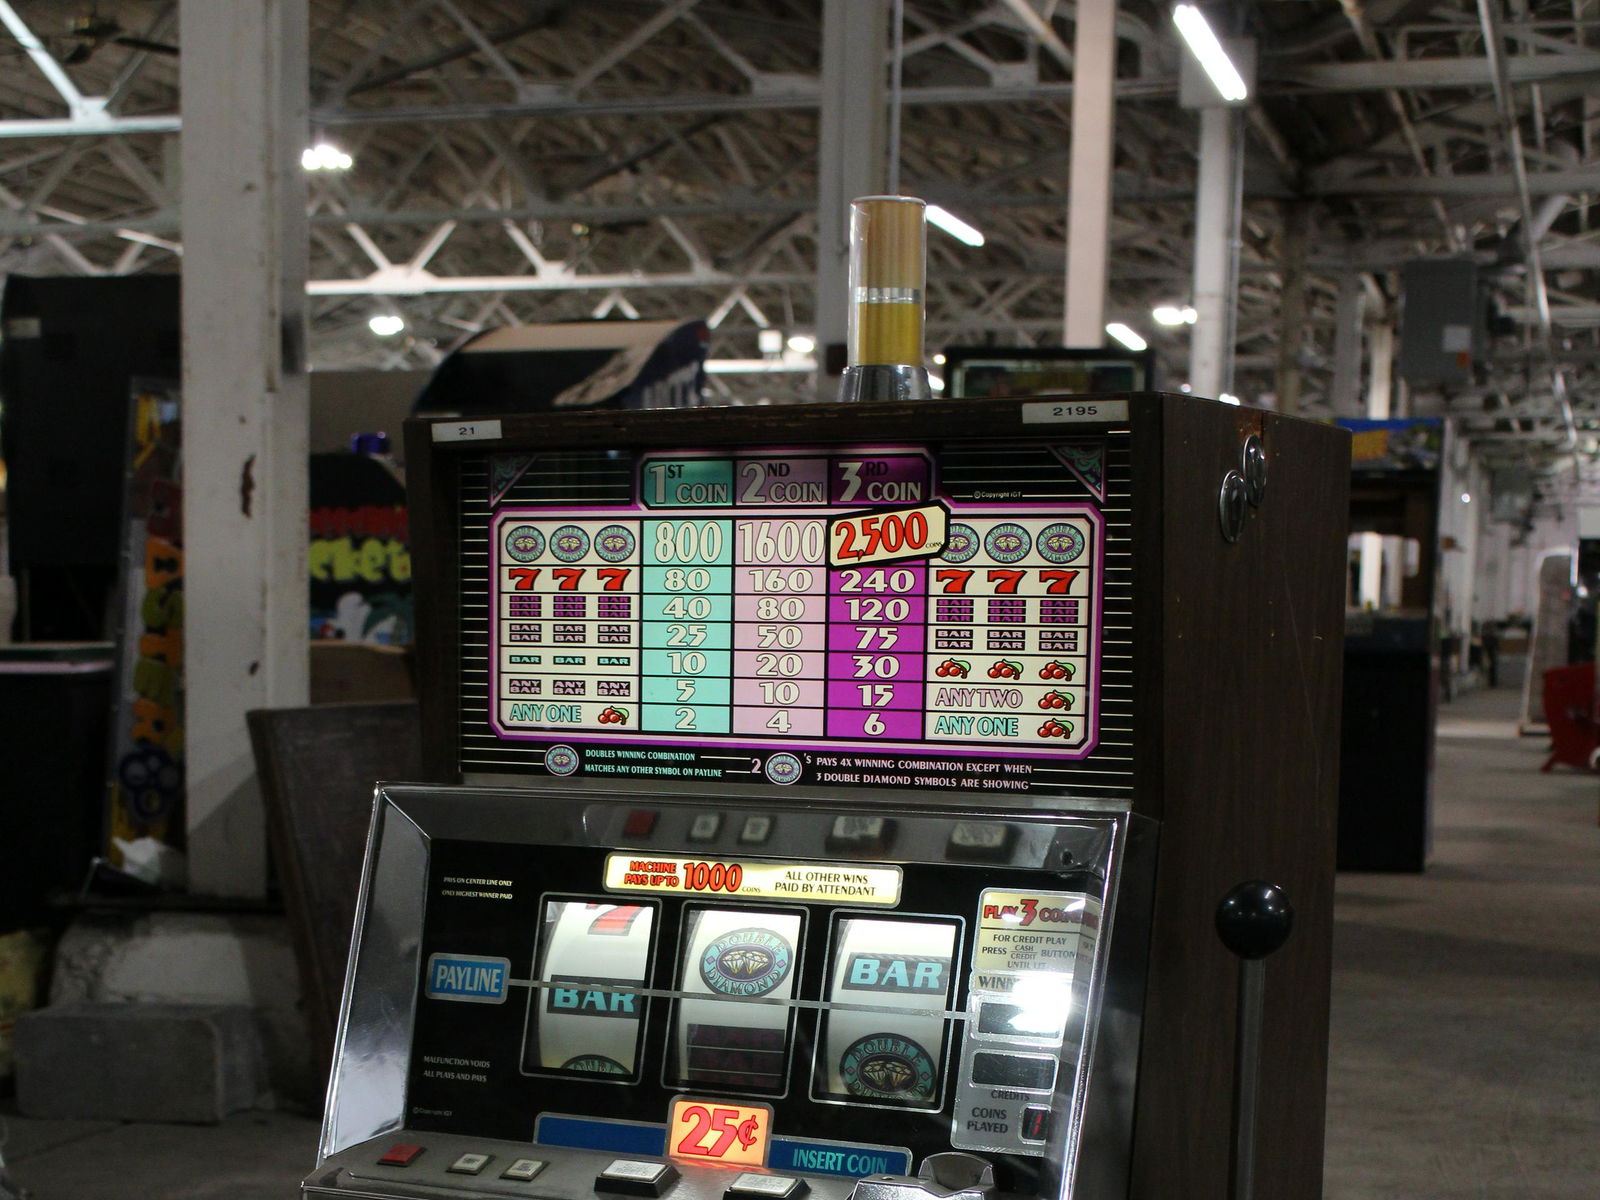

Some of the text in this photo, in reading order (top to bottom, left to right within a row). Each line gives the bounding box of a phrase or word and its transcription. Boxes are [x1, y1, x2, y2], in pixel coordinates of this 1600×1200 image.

[1053, 405, 1098, 417] 2195
[458, 426, 476, 436] 21
[676, 483, 728, 504] COIN
[769, 482, 823, 504] COIN
[866, 481, 921, 502] COIN
[655, 521, 722, 564] 800
[739, 521, 826, 563] 1600
[835, 511, 929, 561] 2,500
[925, 541, 944, 549] COINS
[509, 568, 632, 591] 7 7 7
[663, 568, 711, 592] 80
[748, 568, 813, 593] 160
[839, 568, 916, 594] 240
[936, 569, 1080, 595] 7 7 7
[663, 597, 711, 619] 40
[755, 597, 805, 620] 80
[845, 598, 910, 621] 120
[599, 625, 629, 633] BAR
[599, 635, 629, 643] BAR
[666, 624, 708, 647] 25
[757, 625, 803, 649] 50
[855, 626, 899, 650] 75
[937, 630, 971, 638] BAR
[989, 631, 1023, 639] BAR
[937, 640, 1075, 650] BAR BAR BAR
[599, 657, 629, 665] BAR
[667, 652, 707, 675] 10
[756, 653, 804, 677] 20
[852, 655, 900, 679] 30
[510, 679, 540, 687] ANY
[554, 680, 584, 688] ANY
[510, 686, 630, 696] BAR BAR BAR
[676, 679, 696, 702] 5
[759, 681, 800, 705] 10
[857, 684, 895, 707] 15
[935, 687, 1023, 708] ANY TWO
[509, 703, 582, 723] ANY ONE
[675, 707, 697, 730] 2
[766, 709, 792, 733] 4
[863, 712, 886, 736] 6
[934, 715, 1019, 737] ANY ONE
[585, 749, 696, 761] DOUBLES WINNING COMBINATION
[751, 757, 1032, 774] 2 PAYS 4X WINNING COMBINATION EXCEPT WHEN
[584, 764, 722, 778] MATCHES ANY OTHER SYMBOL ON PAYLINE
[816, 772, 1029, 790] 3 DOUBLE DIAMOND SYMBOLS ARE SHOWING
[624, 873, 680, 887] PAYS UP TO
[629, 861, 677, 874] MACHINE
[683, 862, 743, 892] 1000
[785, 870, 869, 885] ALL OTHER WINS
[774, 881, 877, 896] PAID BY ATTENDANT
[983, 904, 1019, 920] PLAY
[1019, 898, 1039, 927] 3
[716, 930, 787, 955] DOUBLE
[993, 934, 1068, 946] FOR CREDIT PLAY
[981, 946, 1008, 955] PRESS
[1040, 949, 1076, 959] BUTTON
[1010, 952, 1037, 960] CREDIT
[849, 958, 943, 989] BAR
[1007, 960, 1032, 969] UNTIL
[435, 964, 501, 993] PAYLINE
[705, 966, 782, 996] DIAMOND
[553, 981, 635, 1013] BAR
[423, 1055, 491, 1069] MALFUNCTION VOIDS
[854, 1038, 924, 1066] DOUBLE
[423, 1070, 487, 1083] ALL PLAYS AND PAYS
[991, 1089, 1030, 1101] CREDITS
[971, 1106, 1007, 1120] COINS
[1032, 1111, 1043, 1136] 1
[677, 1105, 759, 1158] 25¢
[966, 1120, 1009, 1134] PLAYED
[792, 1148, 888, 1175] INSERT COIN
